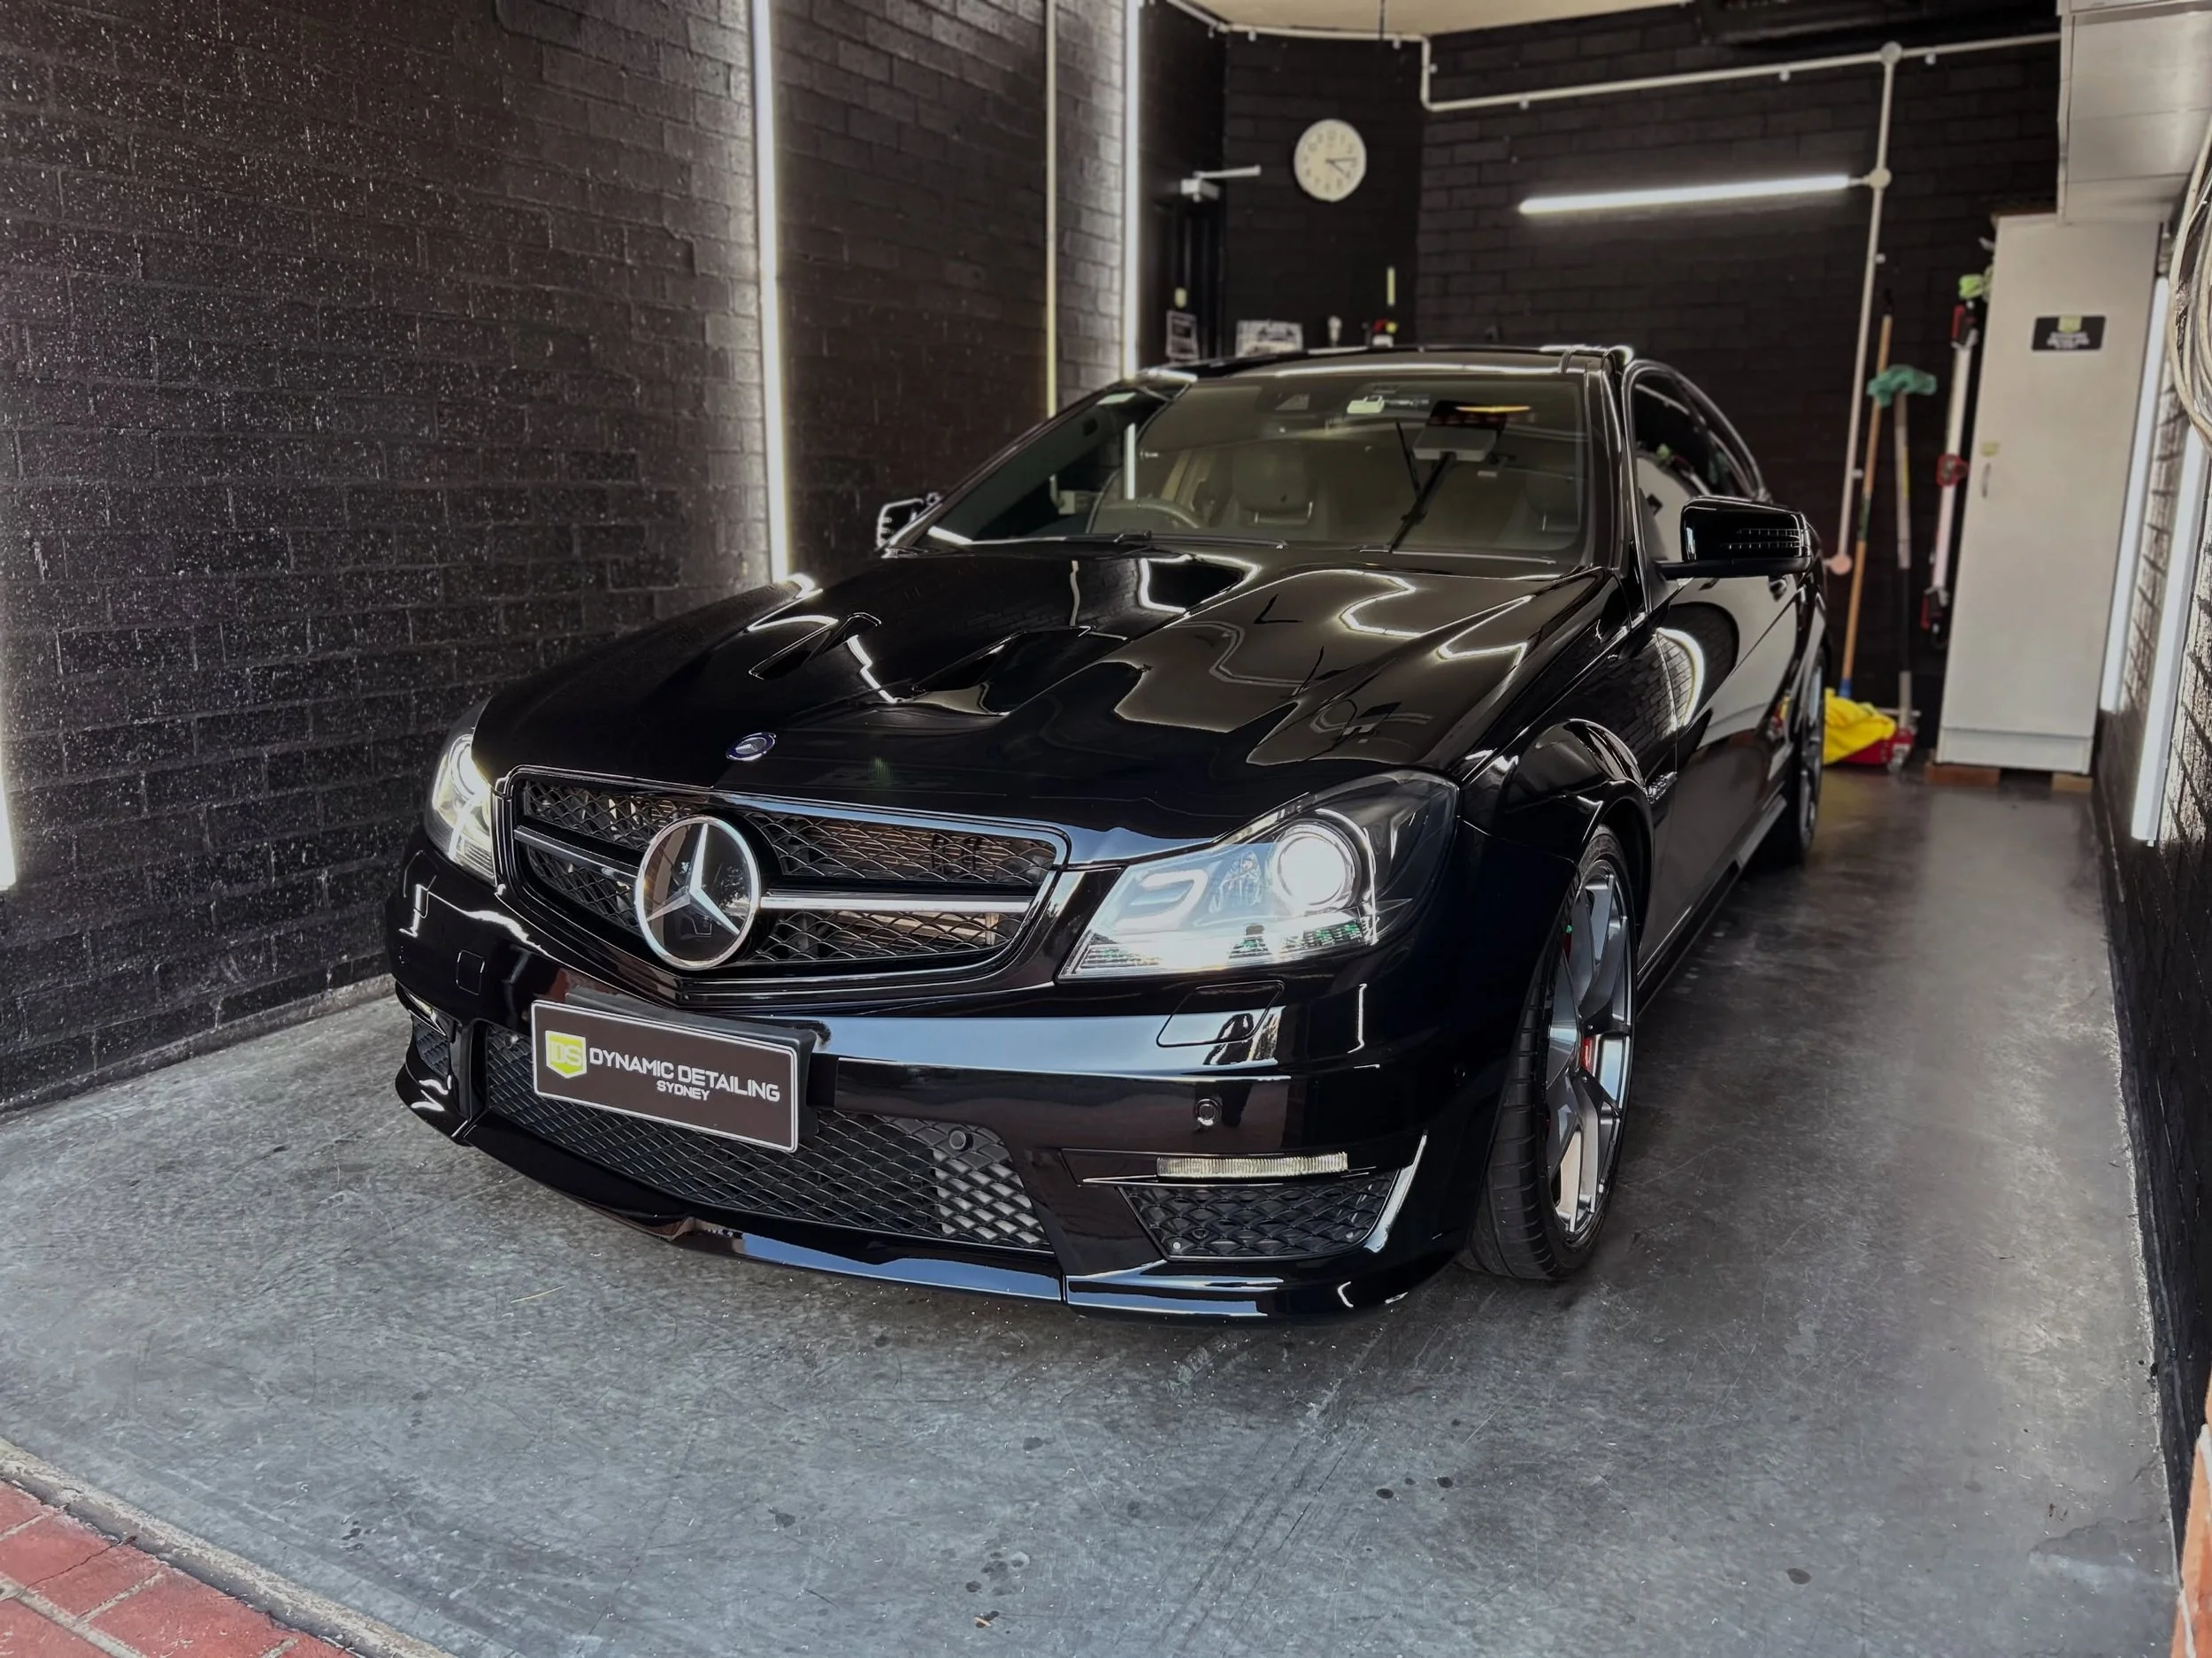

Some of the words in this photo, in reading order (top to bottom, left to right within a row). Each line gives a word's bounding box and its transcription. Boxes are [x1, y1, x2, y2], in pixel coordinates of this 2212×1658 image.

[589, 1047, 675, 1078] DYNAMIC
[677, 1064, 780, 1102] DETAILING
[657, 1079, 710, 1101] SYDNEY
